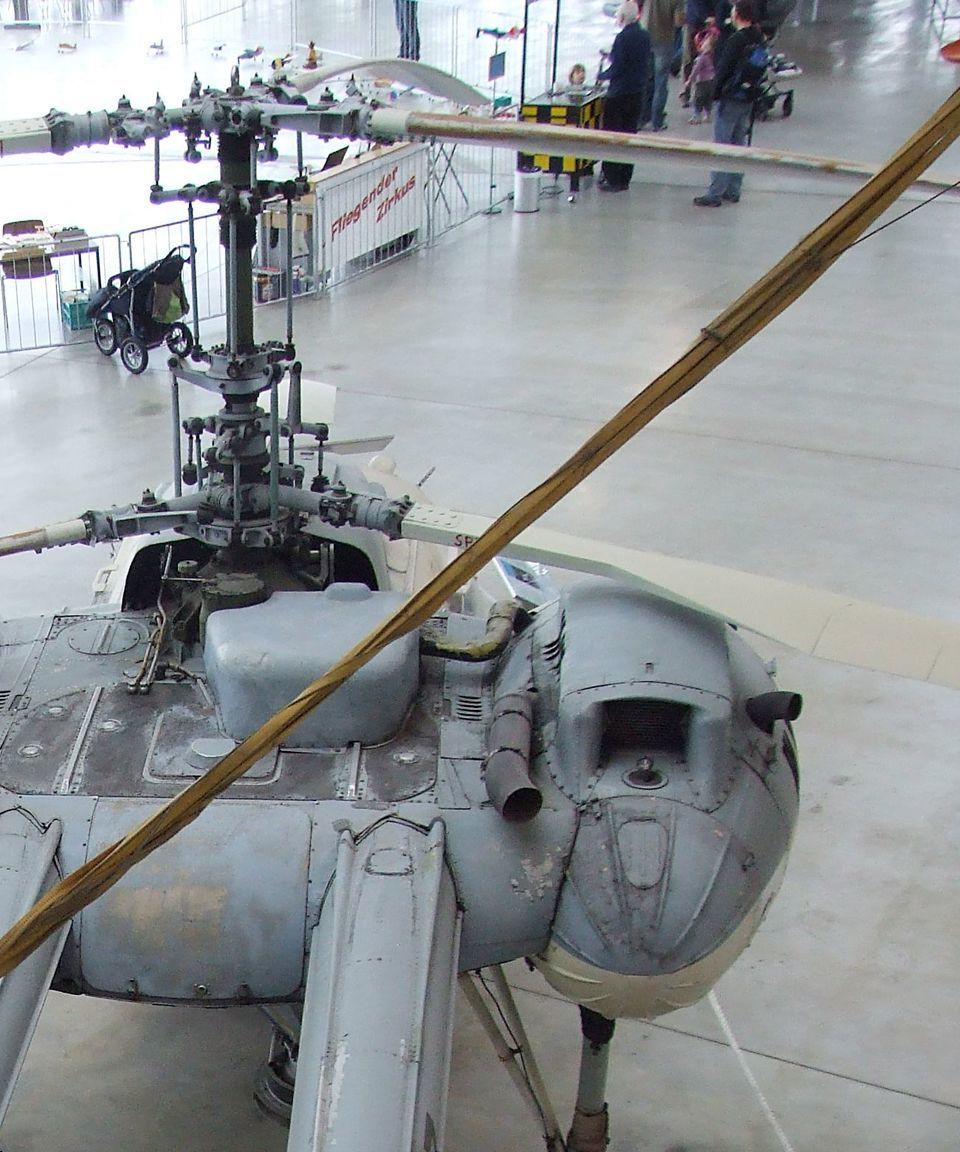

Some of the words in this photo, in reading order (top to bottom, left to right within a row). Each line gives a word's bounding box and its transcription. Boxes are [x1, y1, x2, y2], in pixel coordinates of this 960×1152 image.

[330, 165, 399, 242] Fliegender
[375, 174, 417, 224] Zirkus
[454, 533, 479, 549] SP
